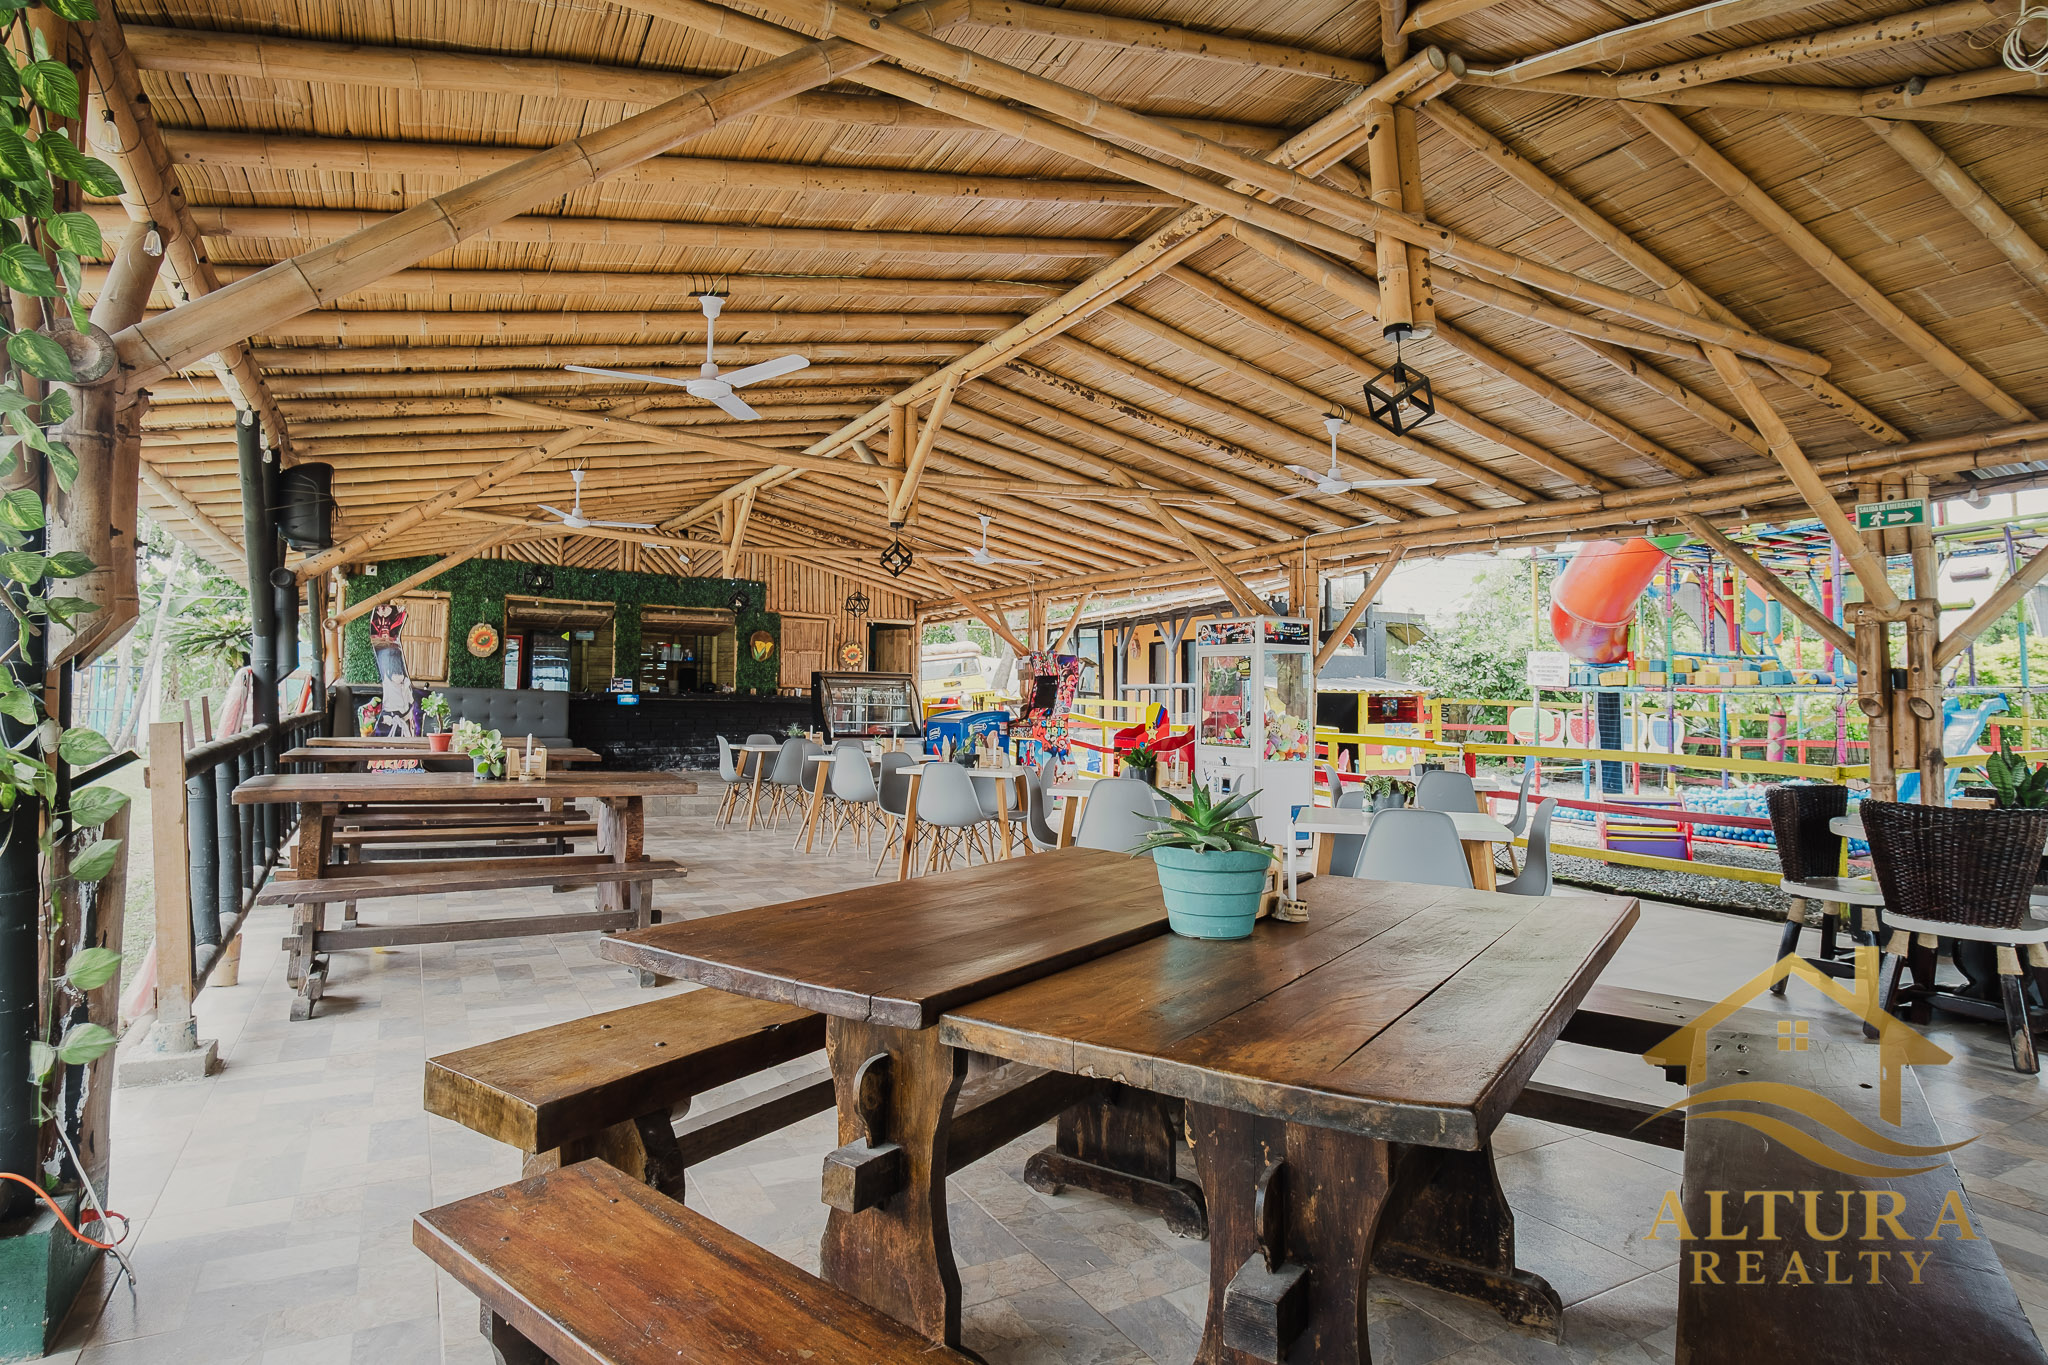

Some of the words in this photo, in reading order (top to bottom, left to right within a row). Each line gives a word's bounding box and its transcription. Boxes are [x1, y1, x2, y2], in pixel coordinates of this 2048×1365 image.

[1859, 505, 1879, 513] SALIDA
[1879, 503, 1886, 511] DE
[1887, 500, 1922, 510] EMERGENCIA
[1041, 720, 1065, 728] SUPER
[1037, 727, 1068, 738] MARIO
[367, 759, 418, 770] NARUTO
